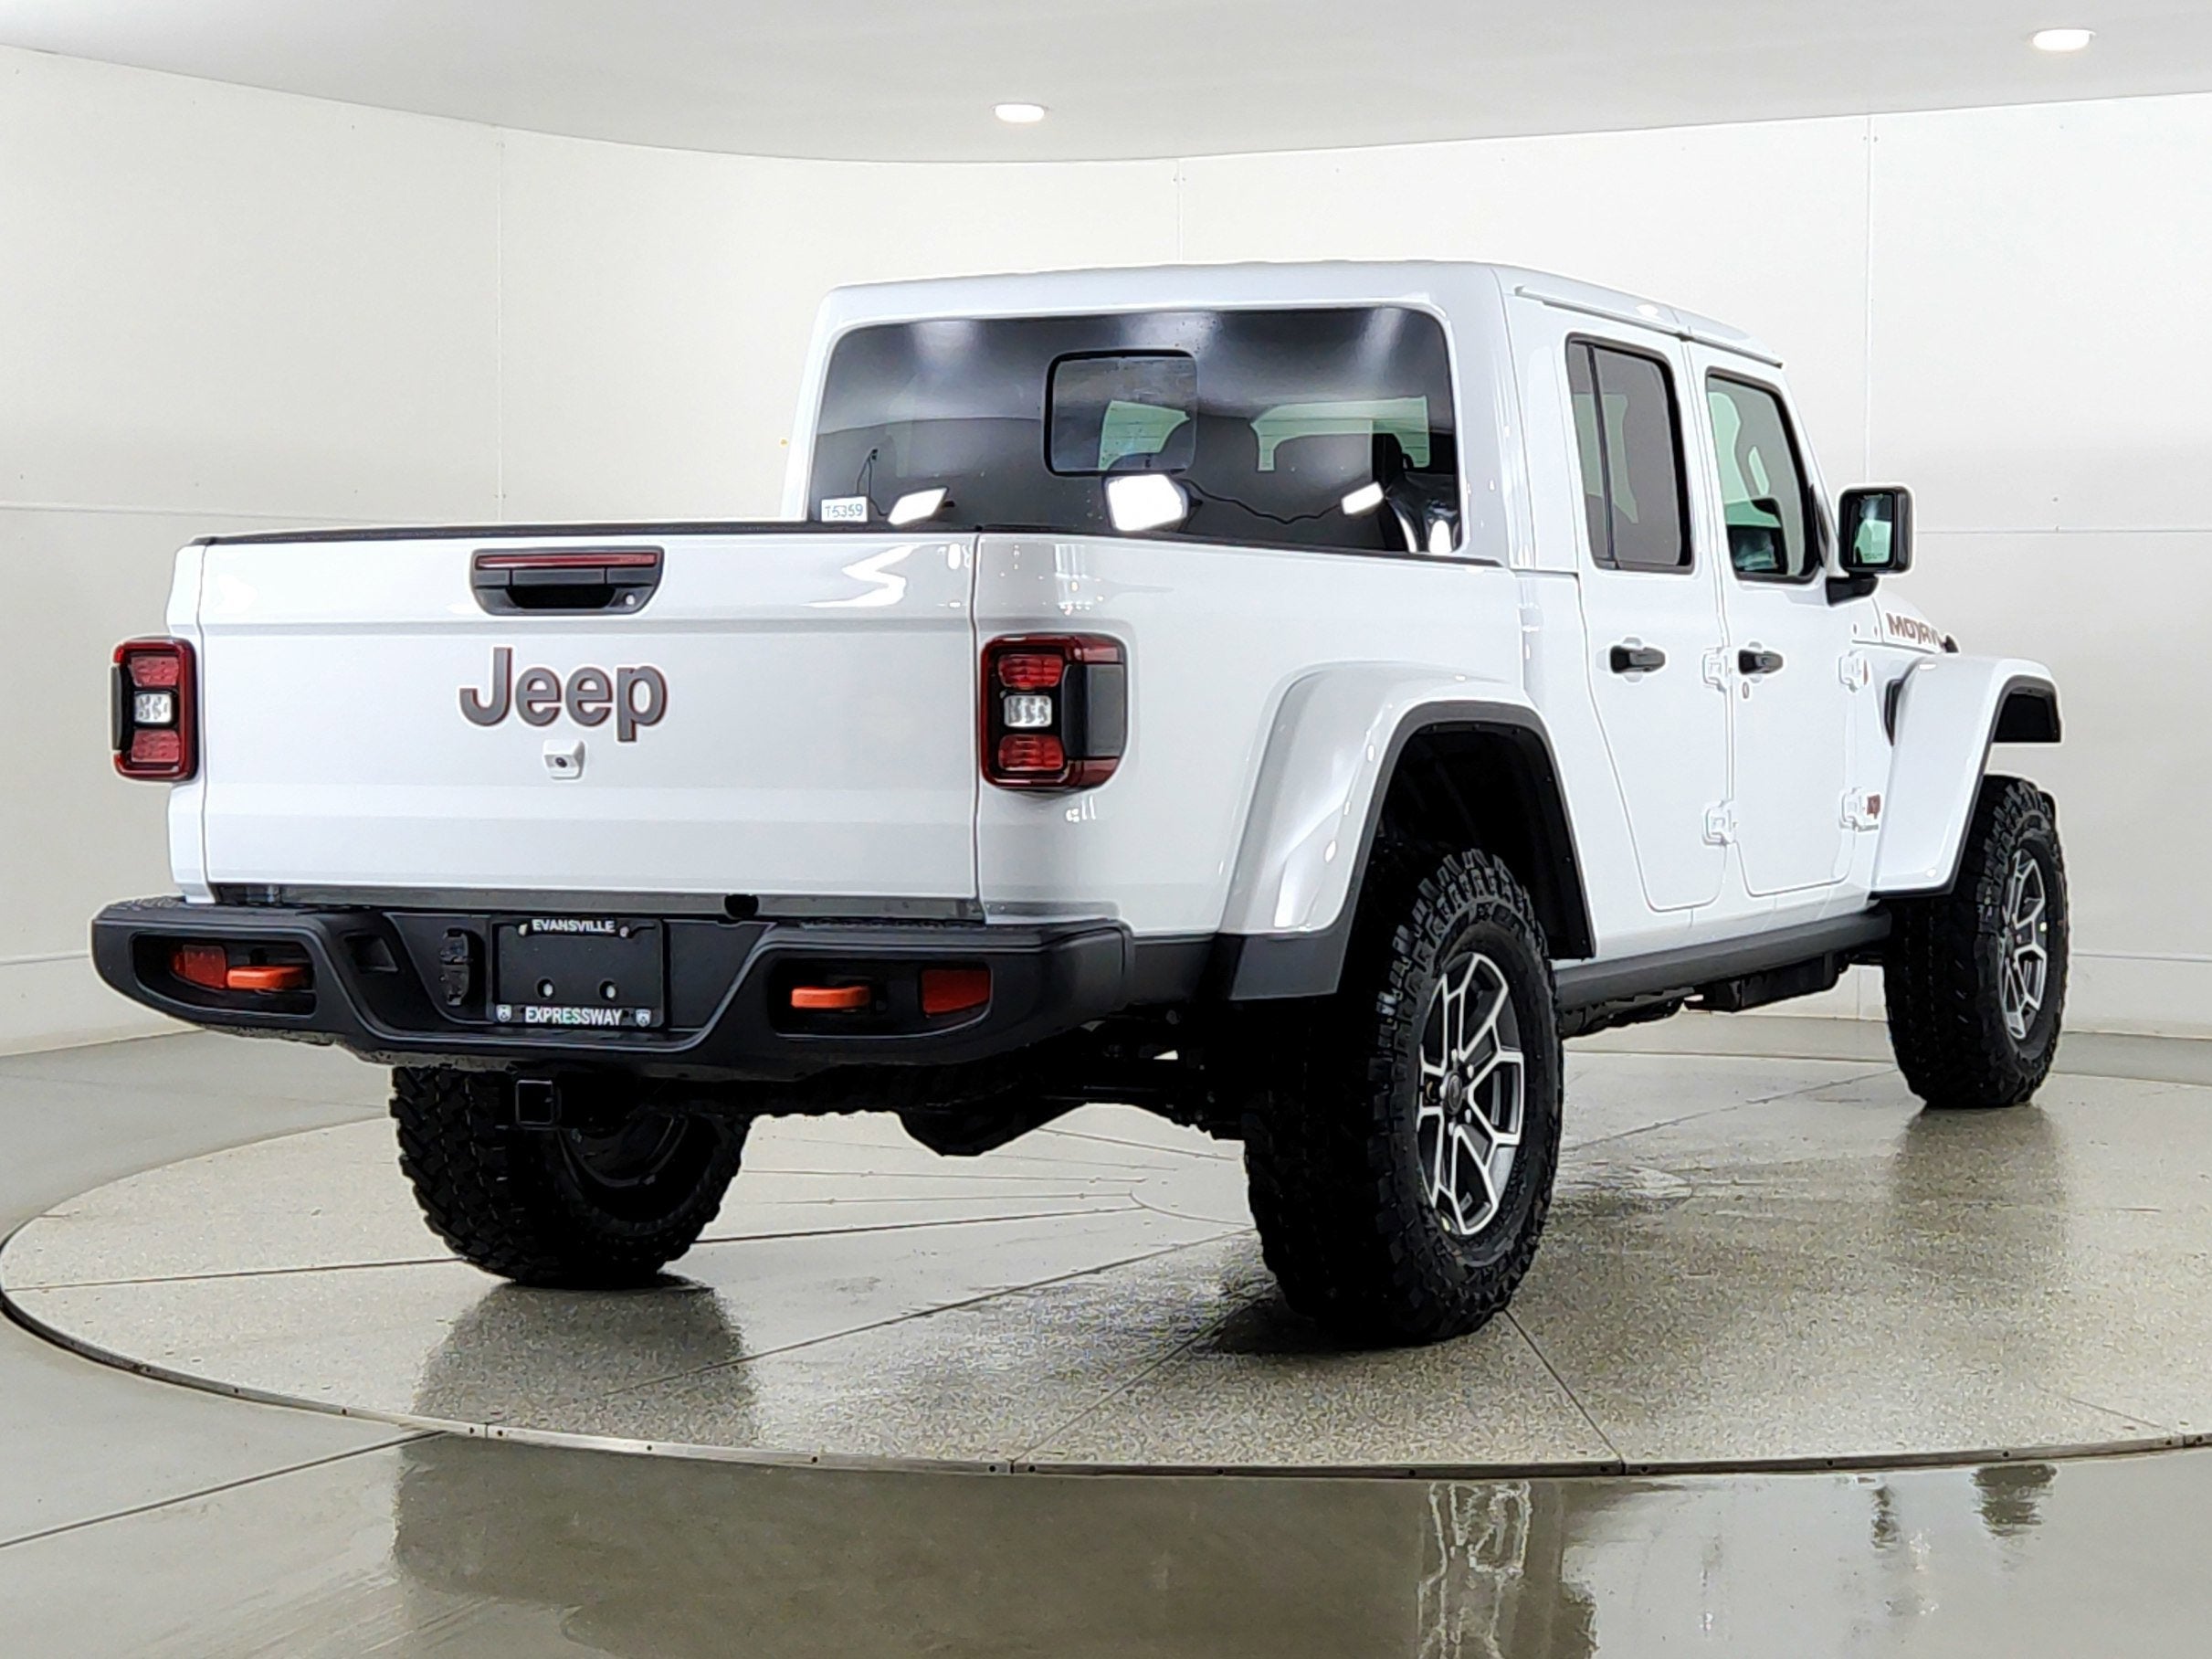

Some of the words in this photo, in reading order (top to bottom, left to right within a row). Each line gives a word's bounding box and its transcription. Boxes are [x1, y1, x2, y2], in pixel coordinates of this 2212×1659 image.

[824, 503, 864, 518] T5359
[459, 647, 668, 742] Jeep
[532, 918, 616, 933] EVANSVILLE
[525, 1006, 623, 1026] EXPRESSWAY
